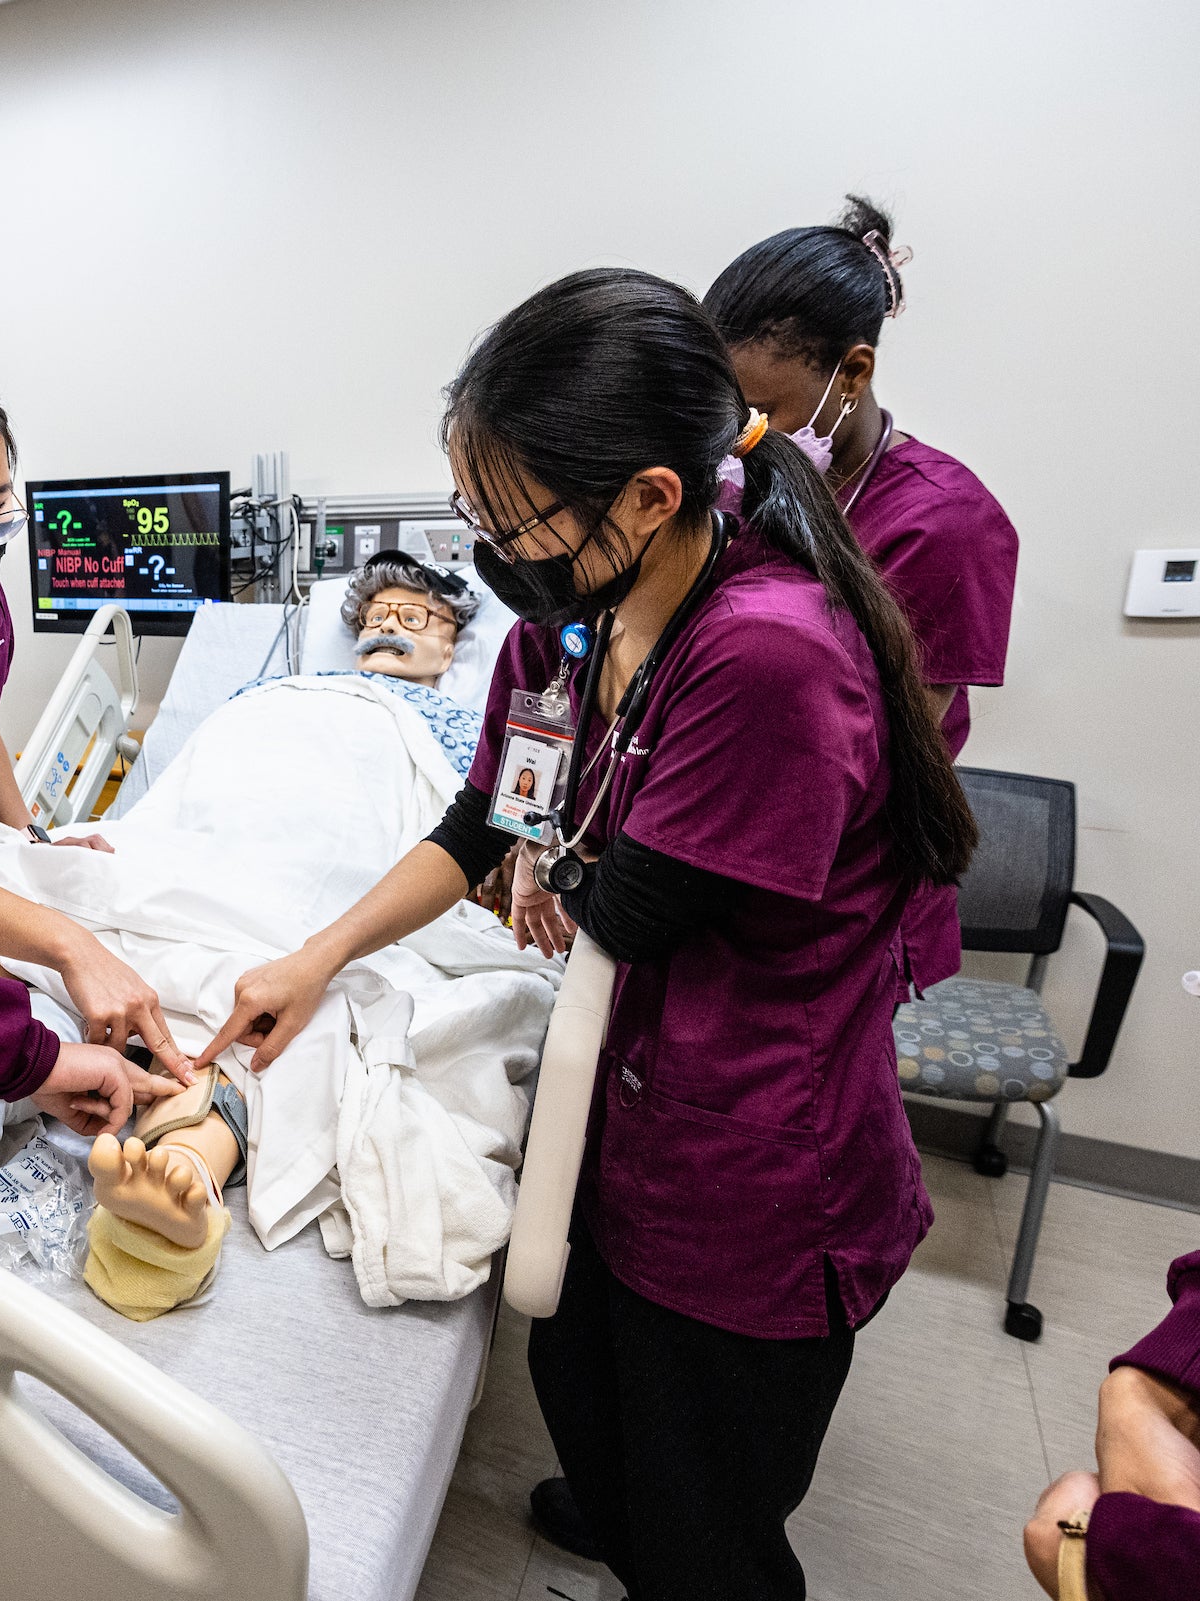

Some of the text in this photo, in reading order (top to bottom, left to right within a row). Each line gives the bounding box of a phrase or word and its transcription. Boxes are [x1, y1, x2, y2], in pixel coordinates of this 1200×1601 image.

[137, 507, 170, 534] 95
[37, 548, 56, 557] NIBP
[55, 556, 125, 573] NIBP No Cuff
[52, 577, 125, 589] Touch when cuff attached
[501, 817, 532, 834] STUDENT
